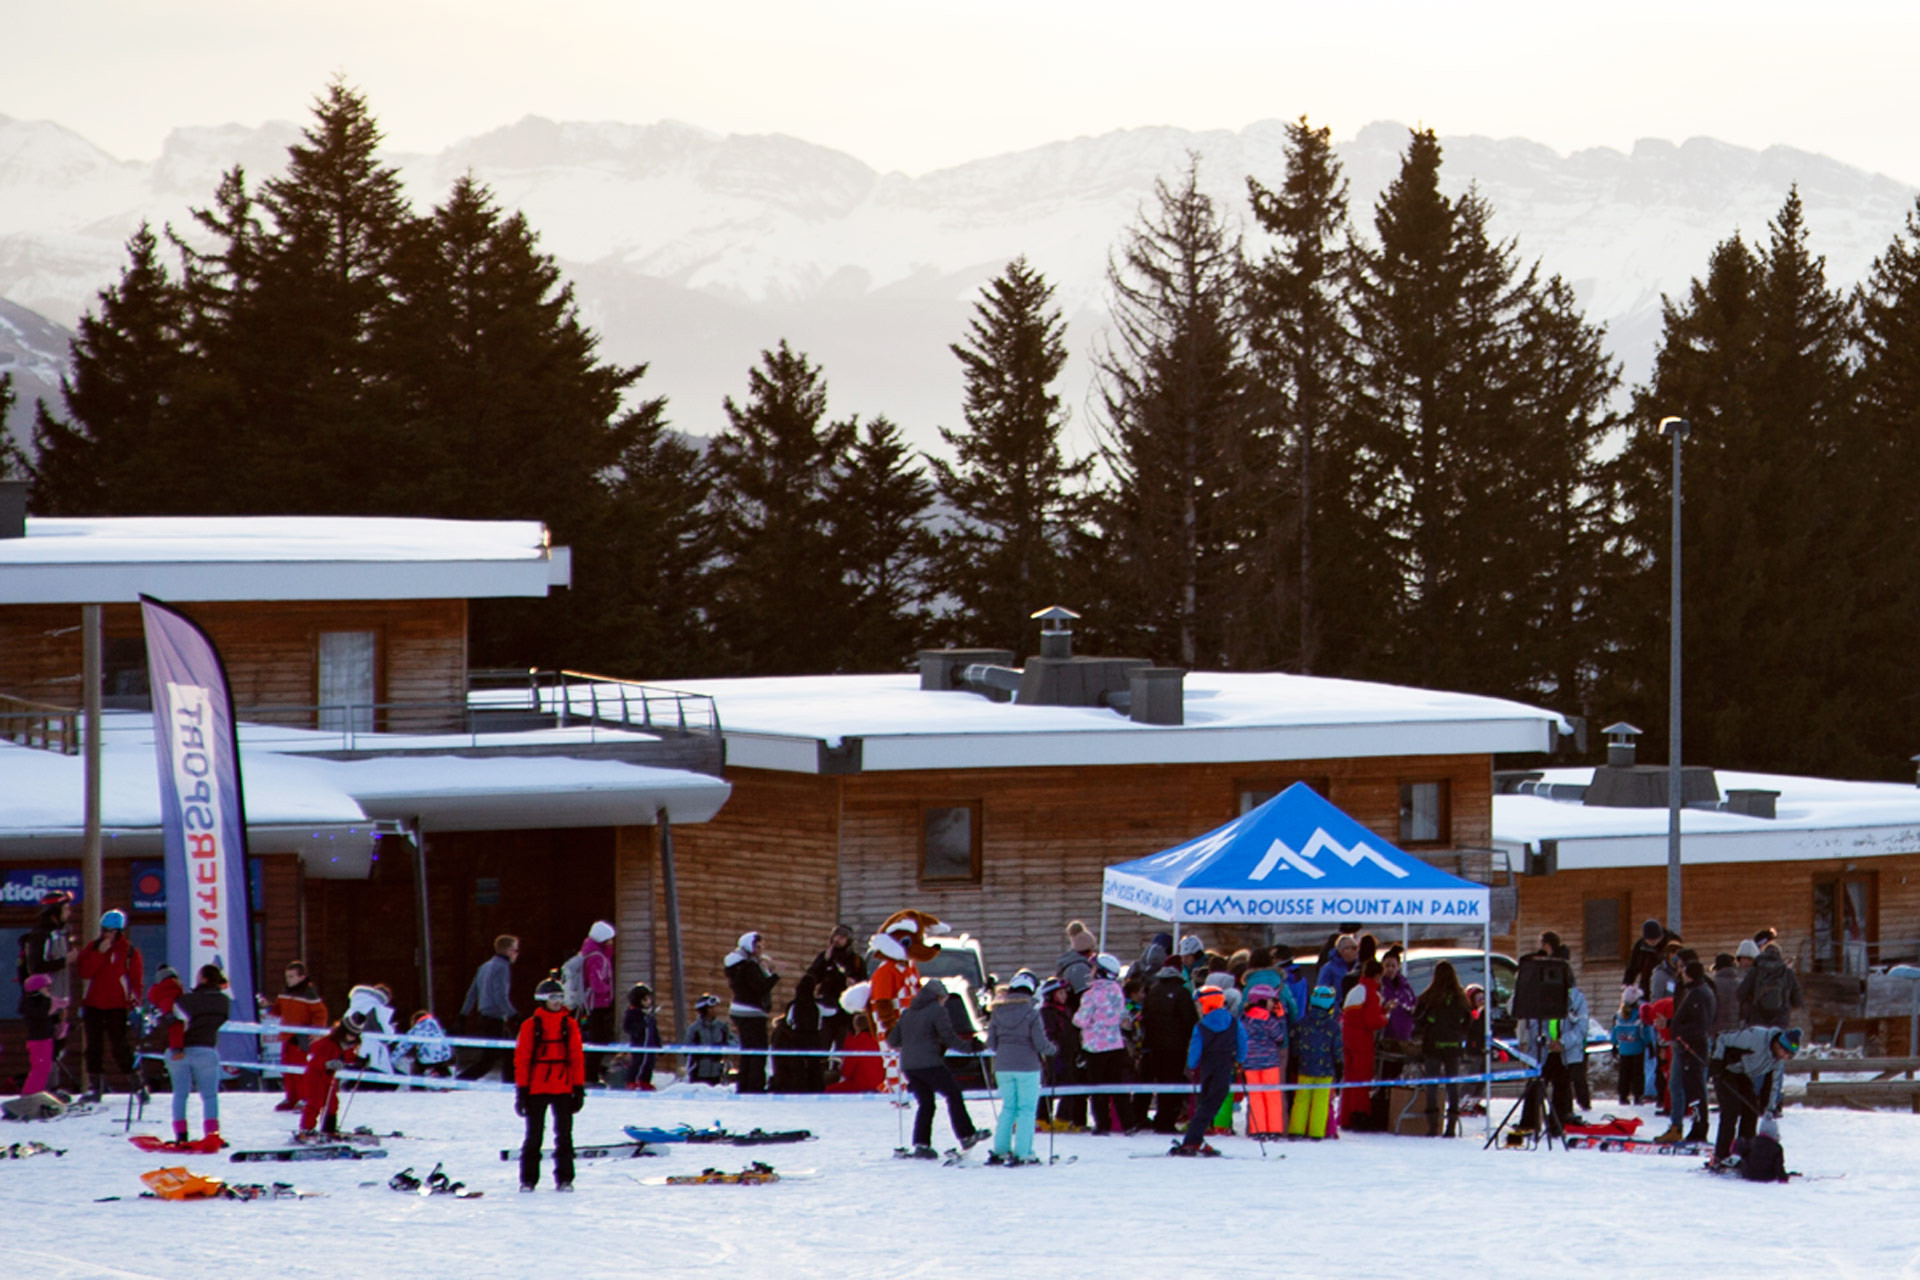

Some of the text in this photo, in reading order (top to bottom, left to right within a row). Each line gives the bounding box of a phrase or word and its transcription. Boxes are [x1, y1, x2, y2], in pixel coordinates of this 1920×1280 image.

[0, 881, 47, 902] tion
[31, 874, 78, 888] Rent
[1183, 895, 1314, 915] CHAMROUSSE
[1321, 898, 1424, 915] MOUNTAIN
[1431, 899, 1480, 916] PARK
